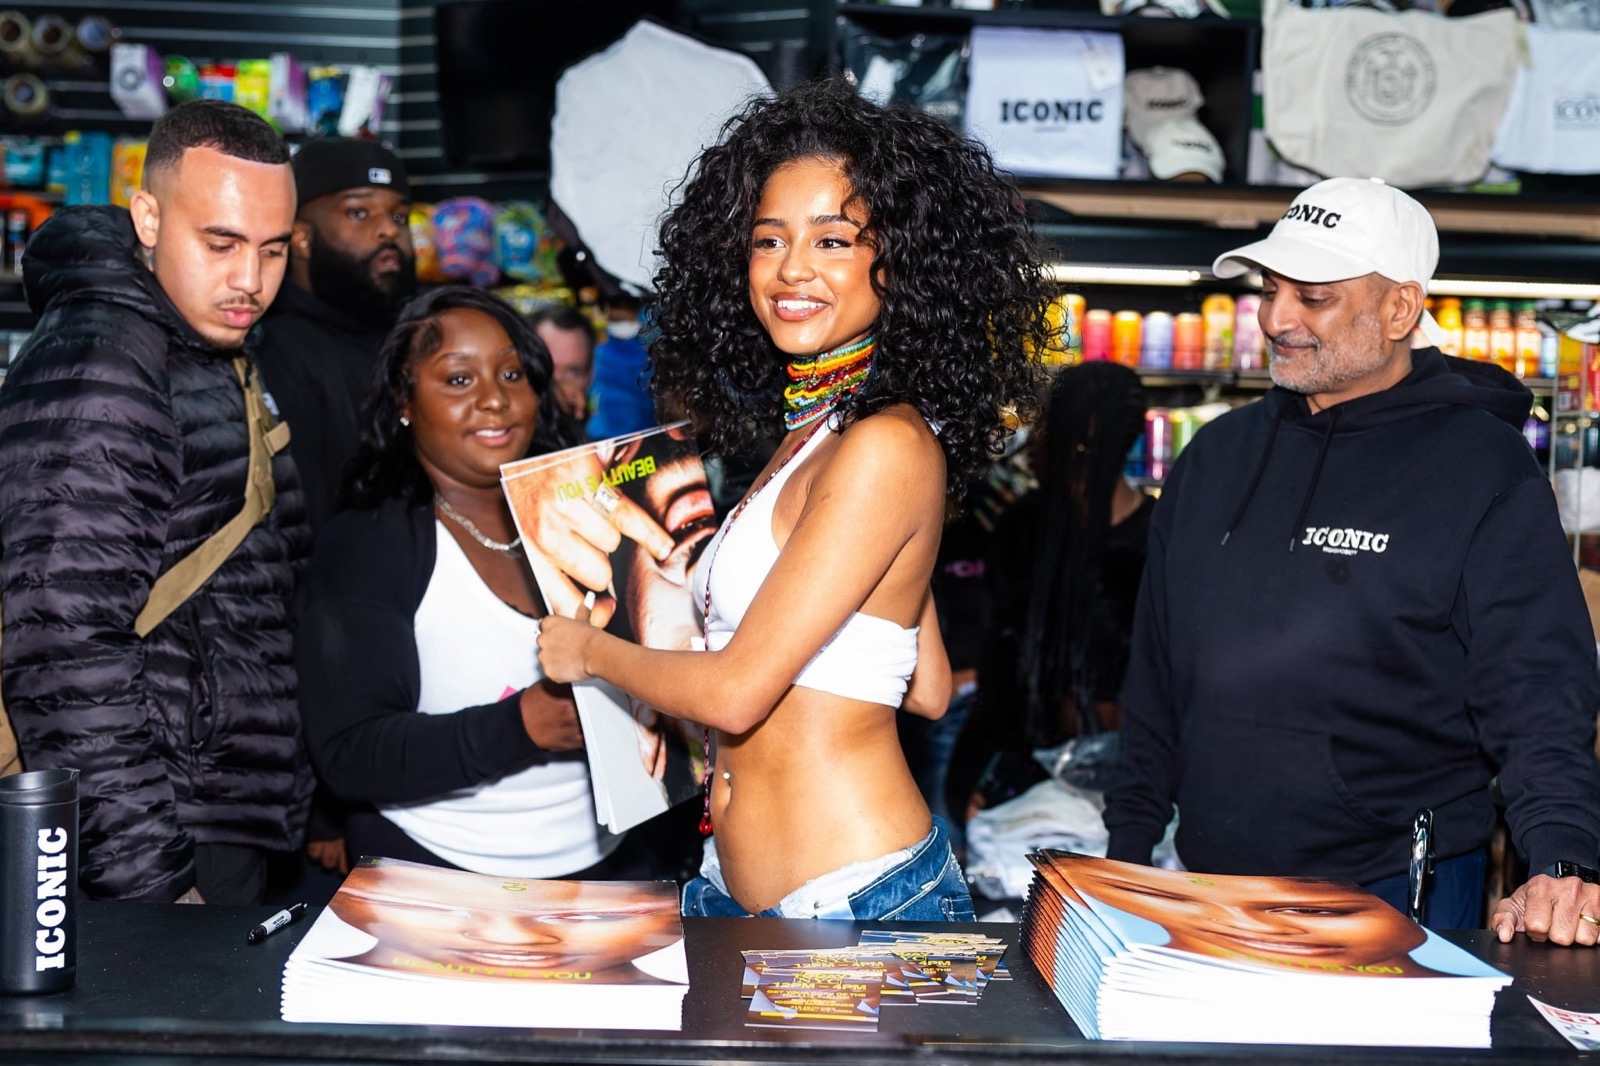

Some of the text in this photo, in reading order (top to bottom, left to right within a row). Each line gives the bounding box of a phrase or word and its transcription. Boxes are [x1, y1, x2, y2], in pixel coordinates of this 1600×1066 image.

[1001, 101, 1103, 121] ICONIC
[1281, 204, 1341, 228] ONIC
[602, 456, 656, 487] BEAUTY
[557, 480, 585, 502] YOU
[1302, 526, 1389, 553] ICONIC
[36, 827, 68, 971] ICONIC
[392, 956, 495, 976] BEAUTY
[542, 970, 592, 980] YOU
[773, 981, 815, 989] 12PM
